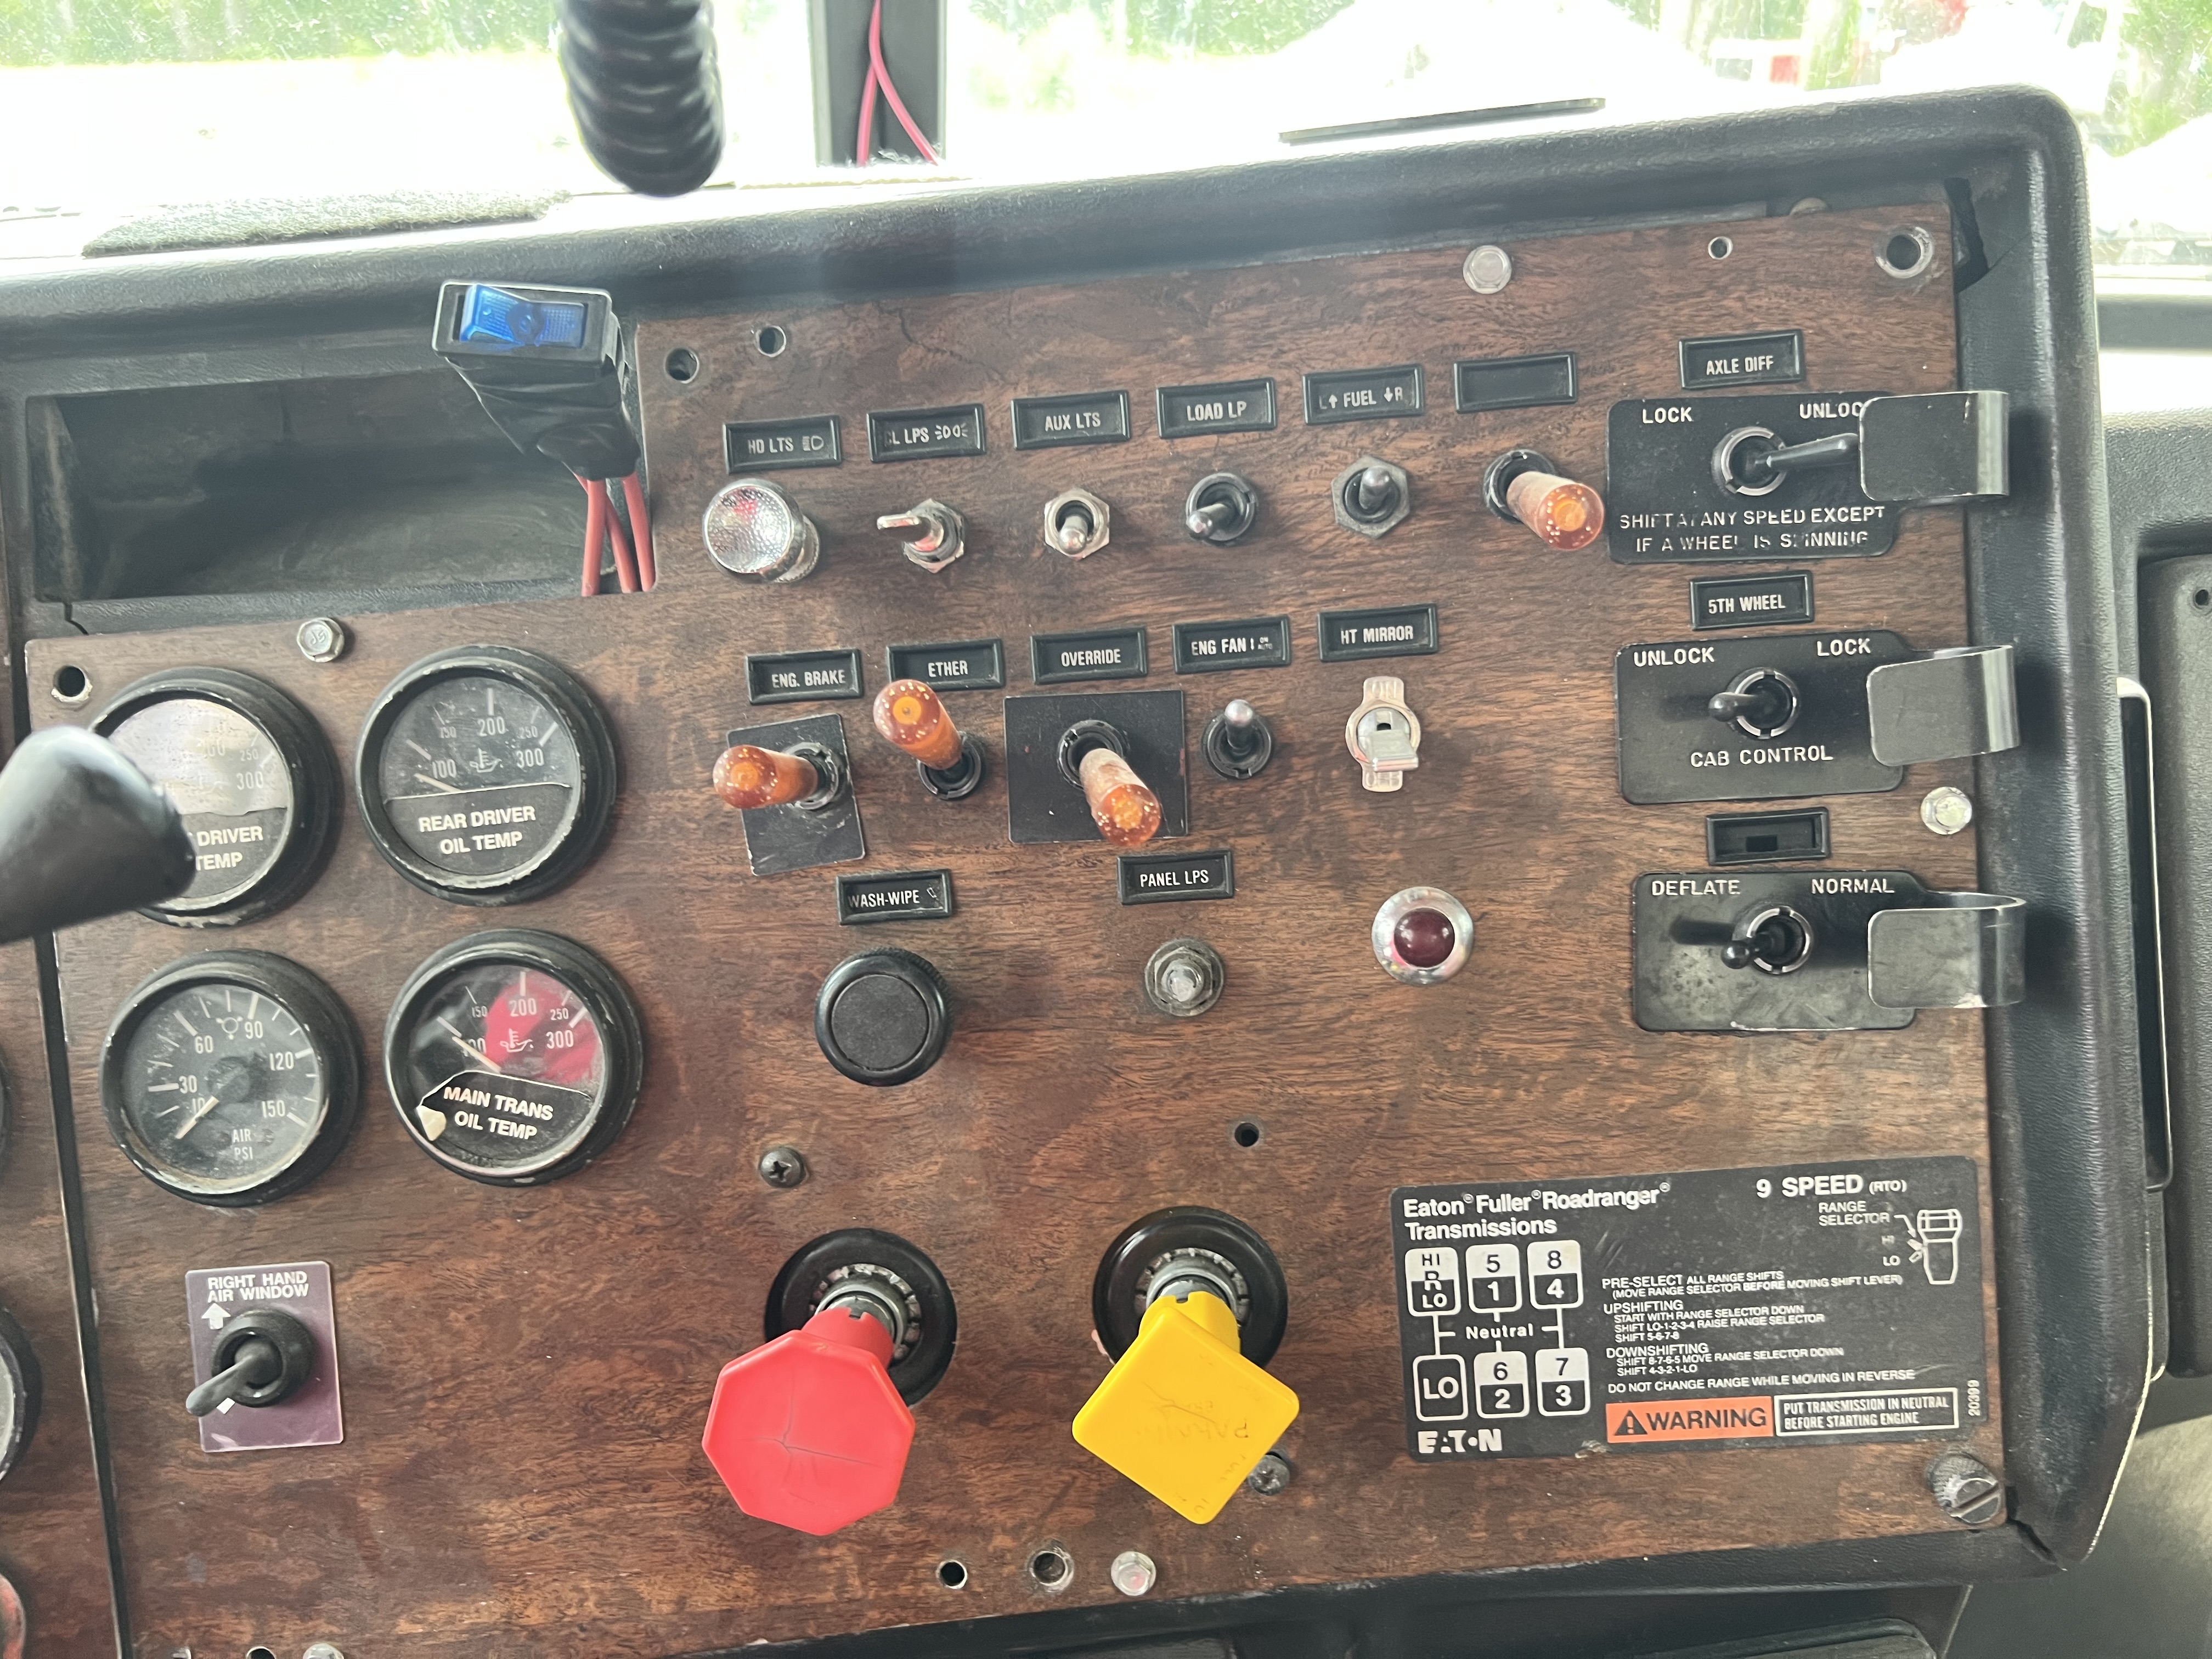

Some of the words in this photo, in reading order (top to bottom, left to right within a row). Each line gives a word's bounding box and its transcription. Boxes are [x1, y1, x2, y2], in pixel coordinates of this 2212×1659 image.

[1706, 358, 1739, 375] AXLE
[1745, 355, 1774, 373] DIFF
[1344, 390, 1377, 407] FUEL
[1395, 387, 1403, 401] R
[1187, 403, 1223, 421] LOAD
[1228, 401, 1248, 419] LP
[1641, 407, 1692, 424] LOCK
[1799, 402, 1863, 419] UNLOC
[1045, 415, 1071, 432] AUX
[1076, 413, 1101, 429] LTS
[769, 437, 794, 453] LTS
[904, 427, 929, 444] LPS
[1620, 514, 1673, 529] SHIFT
[1701, 512, 1737, 527] ANY
[1743, 509, 1806, 525] SPEED
[1811, 506, 1886, 523] EXCEPT
[1637, 538, 1652, 552] IF
[1662, 538, 1673, 551] A
[1754, 535, 1771, 549] IS
[1708, 597, 1735, 614] 5TH
[1740, 595, 1786, 612] WHEEL
[1340, 629, 1358, 645] HT
[1362, 625, 1414, 642] MIRROR
[1191, 640, 1217, 656] ENG
[1221, 637, 1246, 653] FAN
[1816, 638, 1871, 657] LOCK
[1060, 648, 1121, 667] OVERRIDE
[1634, 647, 1715, 668] UNLOCK
[771, 673, 800, 688] ENG.
[805, 669, 845, 686] BRAKE
[928, 660, 968, 678] ETHER
[439, 726, 456, 738] 150
[477, 716, 506, 737] 200
[519, 726, 538, 739] 250
[240, 748, 258, 761] 250
[516, 748, 545, 769] 300
[1690, 751, 1730, 768] CAB
[1740, 746, 1833, 766] CONTROL
[432, 759, 457, 779] 100
[236, 771, 263, 790] 300
[419, 813, 467, 833] REAR
[471, 806, 536, 827] DRIVER
[198, 826, 263, 847] DRIVER
[440, 838, 470, 855] OIL
[473, 831, 523, 851] TEMP
[196, 852, 243, 871] TEMP
[1139, 872, 1181, 888] PANEL
[1184, 869, 1209, 885] LPS
[1651, 879, 1741, 897] DEFLATE
[1811, 878, 1895, 895] NORMAL
[848, 889, 920, 909] WASH-WIPE
[472, 1006, 488, 1018] 150
[509, 998, 537, 1017] 200
[550, 1007, 569, 1020] 250
[244, 1020, 263, 1040] 90
[545, 1030, 574, 1049] 300
[195, 1035, 214, 1054] 60
[269, 1051, 294, 1071] 120
[178, 1075, 198, 1093] 30
[262, 1100, 286, 1118] 150
[443, 1087, 491, 1107] MAIN
[494, 1095, 554, 1120] TRANS
[454, 1111, 483, 1131] OIL
[488, 1118, 537, 1140] TEMP
[232, 1129, 252, 1142] AIR
[234, 1147, 253, 1160] PSI
[1756, 1178, 1771, 1198] 9
[1782, 1175, 1864, 1198] SPEED
[1869, 1180, 1907, 1195] (RTO)
[1819, 1200, 1866, 1214] RANGE
[1819, 1212, 1891, 1226] SELECTOR
[1404, 1217, 1558, 1241] Transmissions
[1421, 1253, 1440, 1266] HI
[1486, 1254, 1500, 1273] 5
[1547, 1250, 1562, 1269] 8
[1883, 1255, 1901, 1266] LO
[207, 1274, 256, 1289] RIGHT
[262, 1271, 308, 1286] HAND
[1424, 1271, 1442, 1291] R
[1547, 1278, 1565, 1299] 4
[1602, 1274, 1683, 1289] PRE-SELECT
[1686, 1276, 1706, 1285] ALL
[1708, 1273, 1745, 1283] RANGE
[1746, 1271, 1784, 1282] SHIFTS
[1612, 1288, 1646, 1300] (MOVE
[1648, 1286, 1684, 1296] RANGE
[1686, 1283, 1742, 1295] SELECTOR
[1743, 1280, 1786, 1291] BEFORE
[1787, 1278, 1830, 1289] MOVING
[1831, 1276, 1861, 1287] SHIFT
[207, 1289, 234, 1303] AIR
[240, 1283, 309, 1300] WINDOW
[1422, 1293, 1447, 1308] LO
[1487, 1281, 1499, 1301] 1
[1603, 1299, 1684, 1314] UPSHIFTING
[1614, 1313, 1645, 1323] START
[1647, 1312, 1674, 1321] WITH
[1676, 1310, 1713, 1320] RANGE
[1714, 1307, 1769, 1318] SELECTOR
[1771, 1305, 1804, 1315] DOWN
[1466, 1323, 1533, 1340] Neutral
[1615, 1323, 1645, 1333] SHIFT
[1646, 1321, 1695, 1331] LO-1-2-3-4
[1697, 1318, 1728, 1328] RAISE
[1730, 1316, 1768, 1327] RANGE
[1769, 1313, 1825, 1325] SELECTOR
[1615, 1333, 1645, 1343] SHIFT
[1647, 1331, 1680, 1341] 5-6-7-8
[1606, 1342, 1709, 1358] DOWNSHIFTING
[1616, 1357, 1646, 1367] SHIFT
[1648, 1355, 1680, 1365] 8-7-6-5
[1683, 1353, 1713, 1363] MOVE
[1714, 1351, 1752, 1361] RANGE
[1753, 1348, 1808, 1360] SELECTOR
[1493, 1362, 1508, 1380] 6
[1555, 1357, 1570, 1376] 7
[1617, 1367, 1647, 1376] SHIFT
[1649, 1364, 1698, 1374] 4-3-2-1-LO
[1423, 1376, 1459, 1400] LO
[1608, 1384, 1626, 1393] DO
[1629, 1381, 1652, 1392] NOT
[1655, 1379, 1705, 1391] CHANGE
[1707, 1377, 1750, 1388] RANGE
[1752, 1375, 1789, 1386] WHILE
[1792, 1372, 1839, 1384] MOVING
[1842, 1372, 1855, 1382] IN
[1857, 1369, 1915, 1381] REVERSE
[1494, 1388, 1510, 1409] 2
[1555, 1385, 1572, 1407] 3
[1784, 1402, 1803, 1415] PUT
[1806, 1398, 1886, 1414] TRANSMISSION
[1887, 1397, 1900, 1410] IN
[1901, 1396, 1949, 1409] NEUTRAL
[1646, 1407, 1767, 1431] WARNING
[1784, 1417, 1824, 1430] BEFORE
[1826, 1413, 1878, 1428] STARTING
[1880, 1411, 1920, 1425] ENGINE
